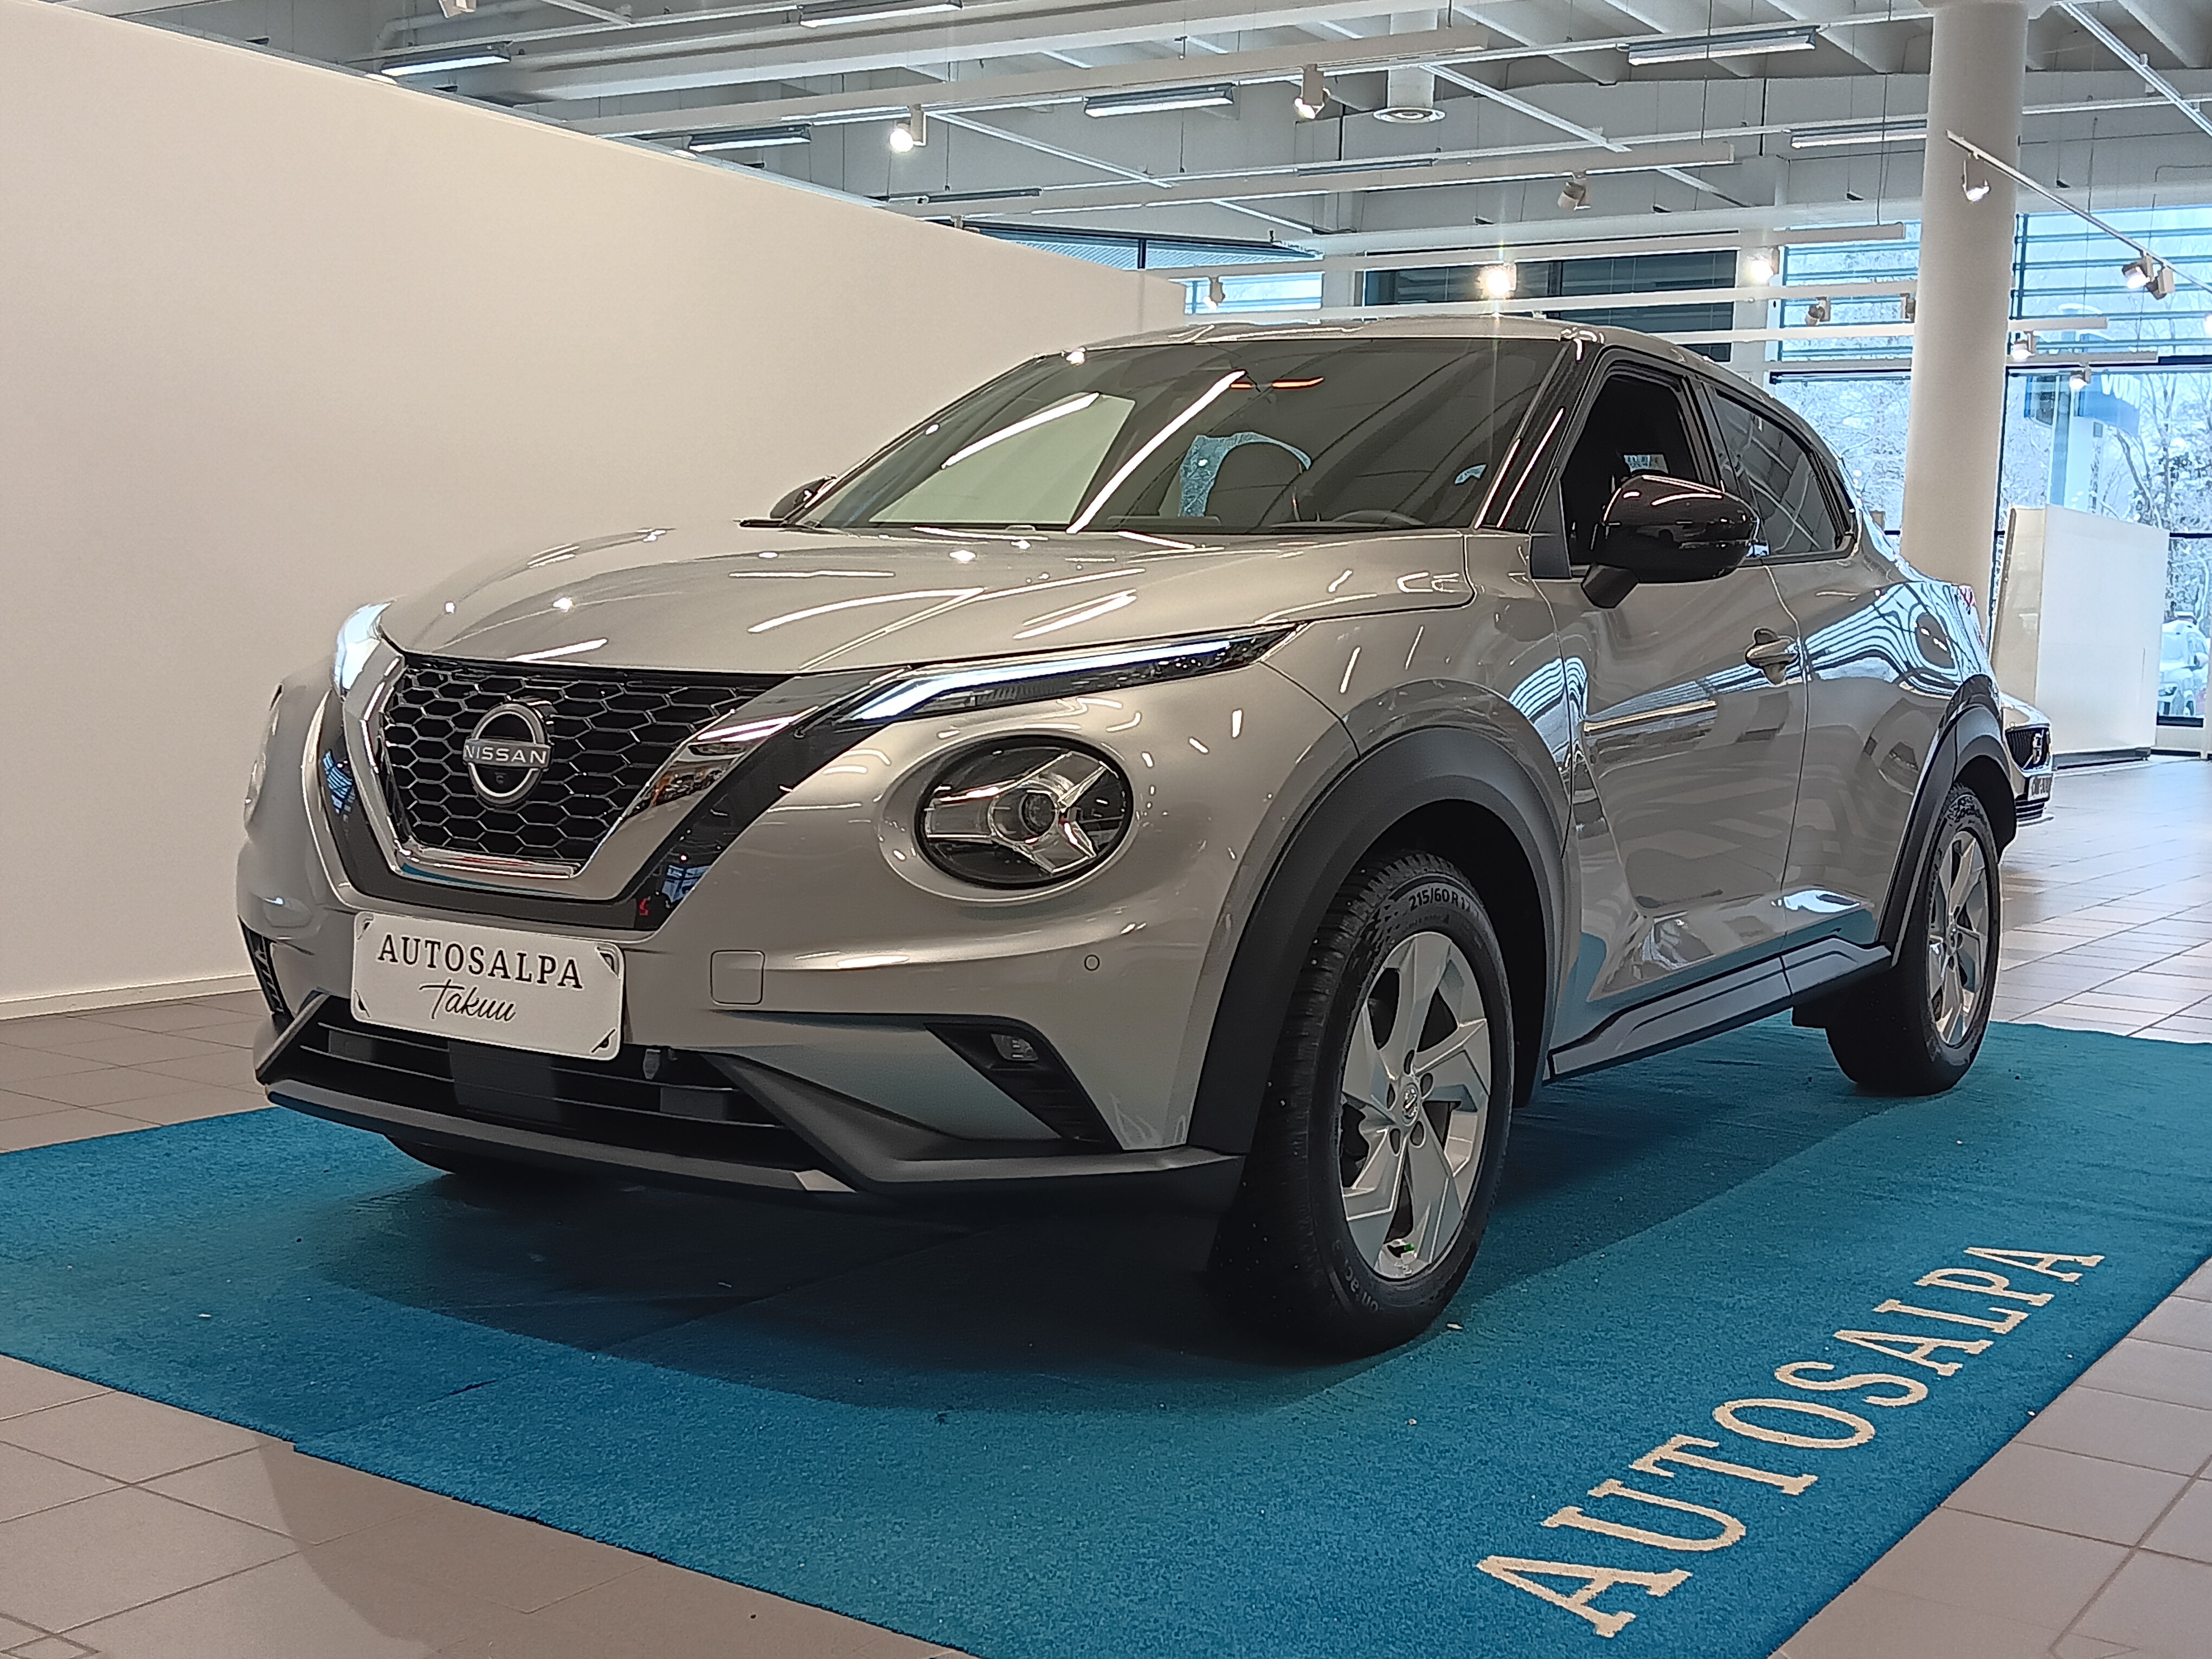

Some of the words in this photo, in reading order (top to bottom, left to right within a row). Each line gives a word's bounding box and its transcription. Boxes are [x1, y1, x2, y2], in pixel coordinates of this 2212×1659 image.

[465, 745, 546, 764] NISSAN
[1409, 888, 1450, 911] 215/60
[377, 934, 583, 989] AUTOSALPA
[419, 979, 516, 1021] Takuu
[1476, 1246, 2105, 1638] AUTOSALPA
